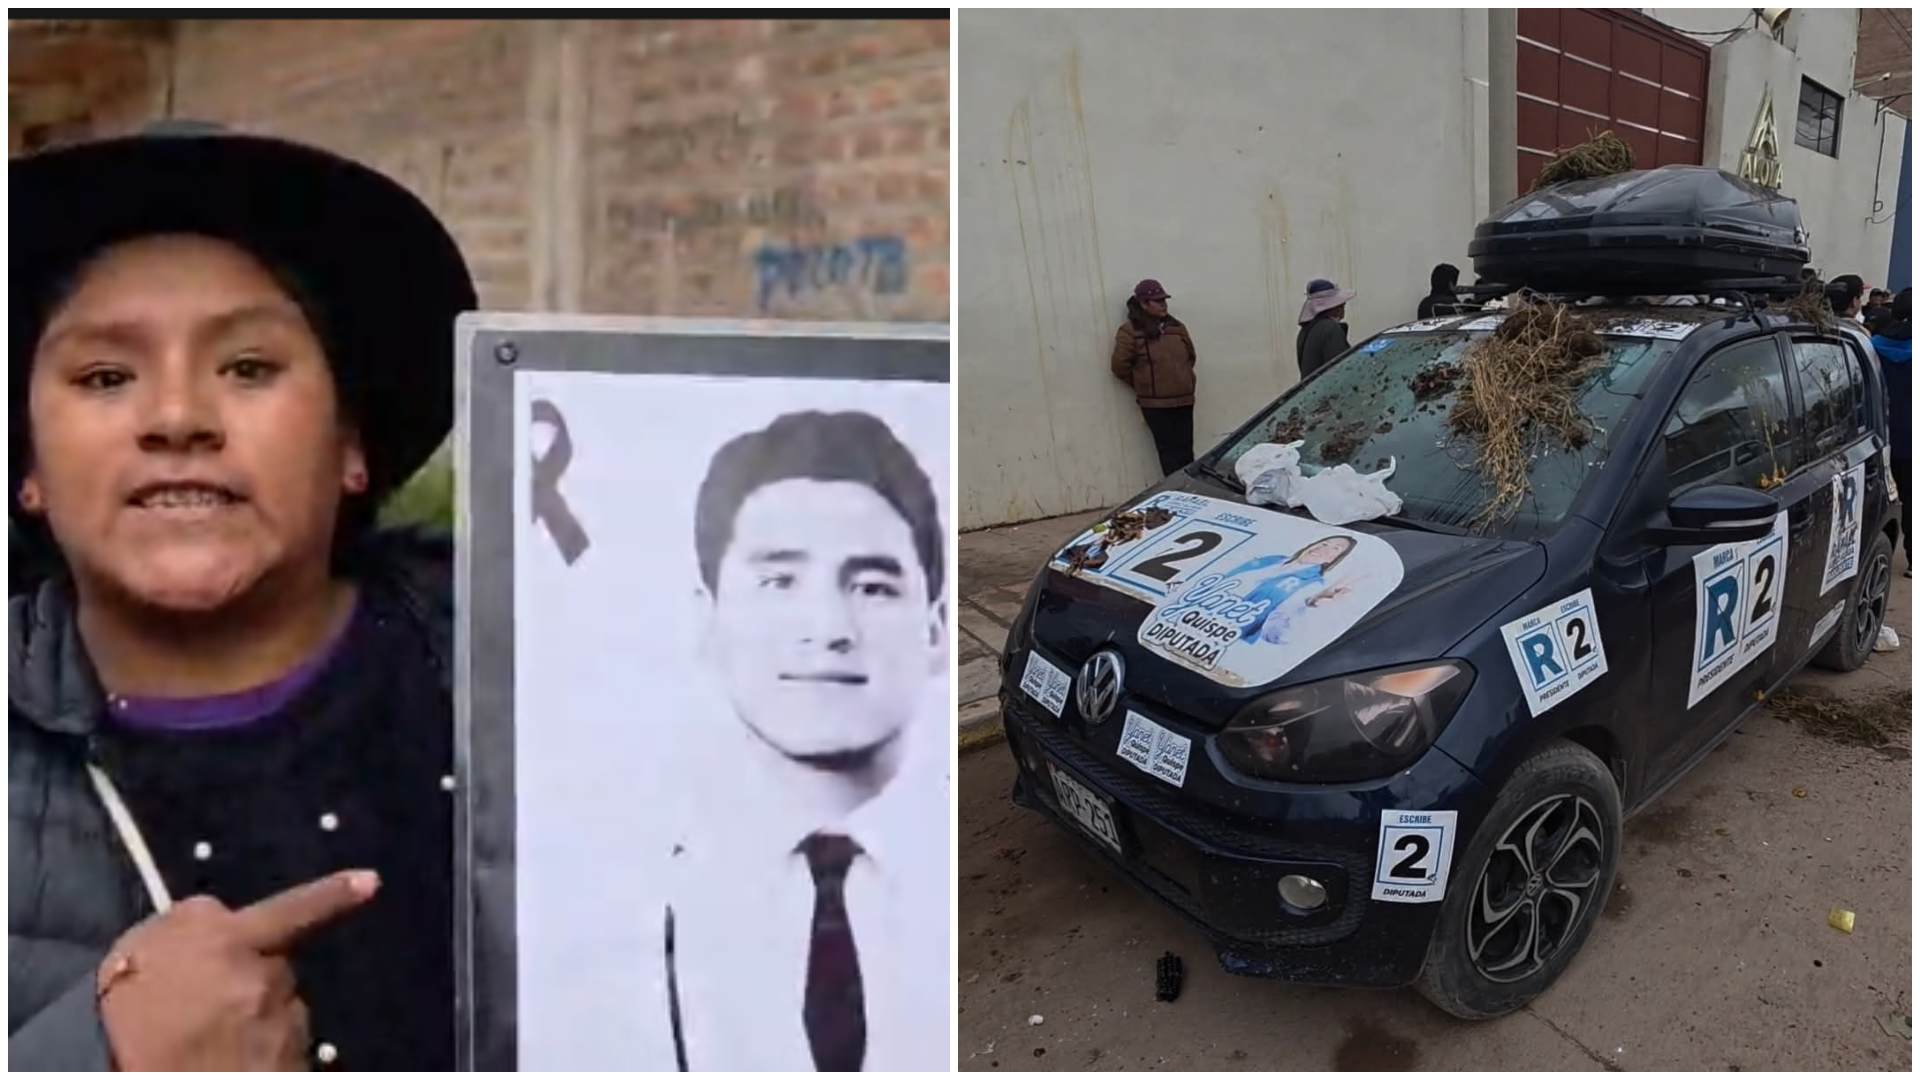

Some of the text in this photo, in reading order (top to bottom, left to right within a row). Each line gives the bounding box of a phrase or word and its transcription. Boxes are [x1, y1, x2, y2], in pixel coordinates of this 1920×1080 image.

[1131, 531, 1222, 582] 2
[1713, 548, 1734, 568] MARCA
[1181, 610, 1237, 642] Quispe
[1703, 575, 1739, 661] R
[1750, 555, 1775, 624] 2
[1147, 623, 1220, 665] DIPUTADA
[1522, 618, 1592, 685] R 2
[1399, 815, 1432, 824] ESCRIBE
[1390, 834, 1430, 878] 2
[1383, 888, 1427, 898] DIPUTADA
